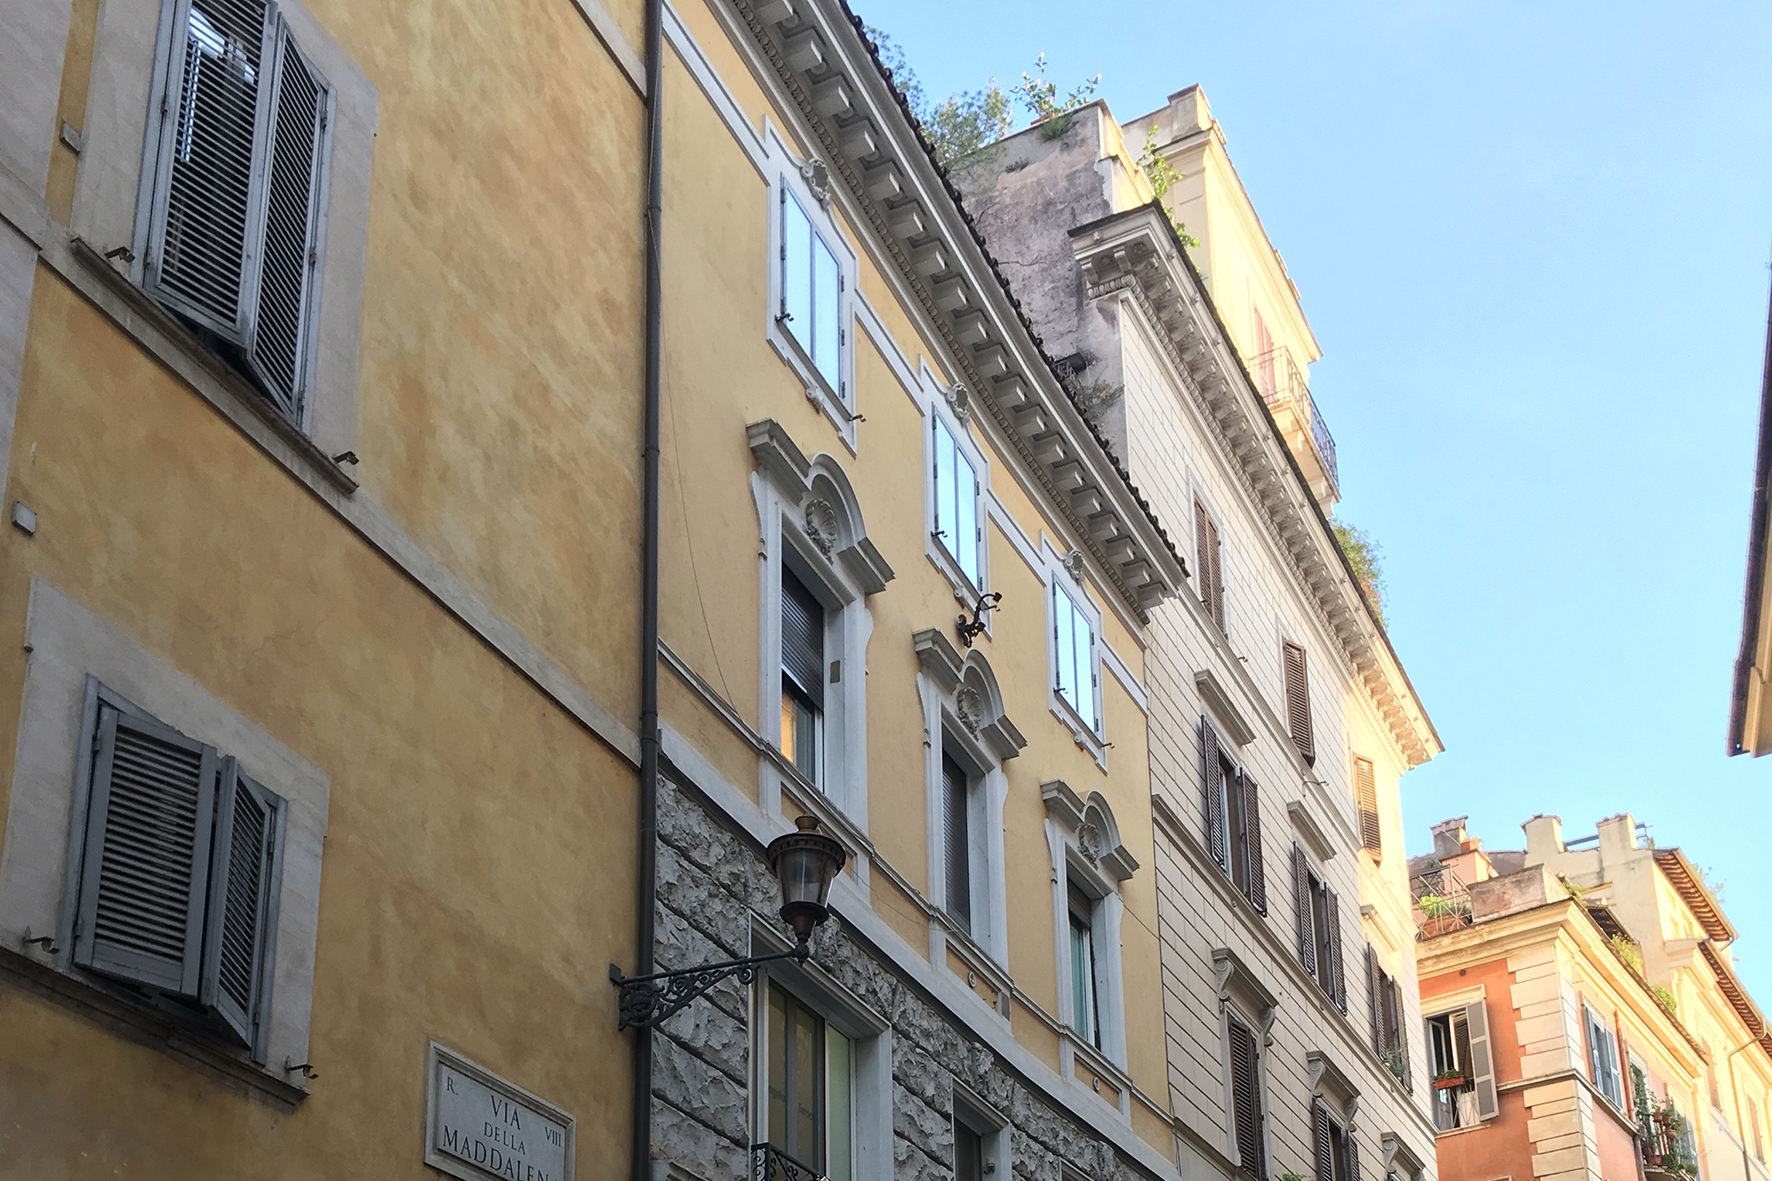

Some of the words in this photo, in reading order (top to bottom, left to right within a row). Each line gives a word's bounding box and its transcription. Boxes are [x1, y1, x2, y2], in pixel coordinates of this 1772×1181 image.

[447, 1077, 459, 1096] R.
[491, 1095, 521, 1130] VIA
[484, 1121, 526, 1155] DELLA
